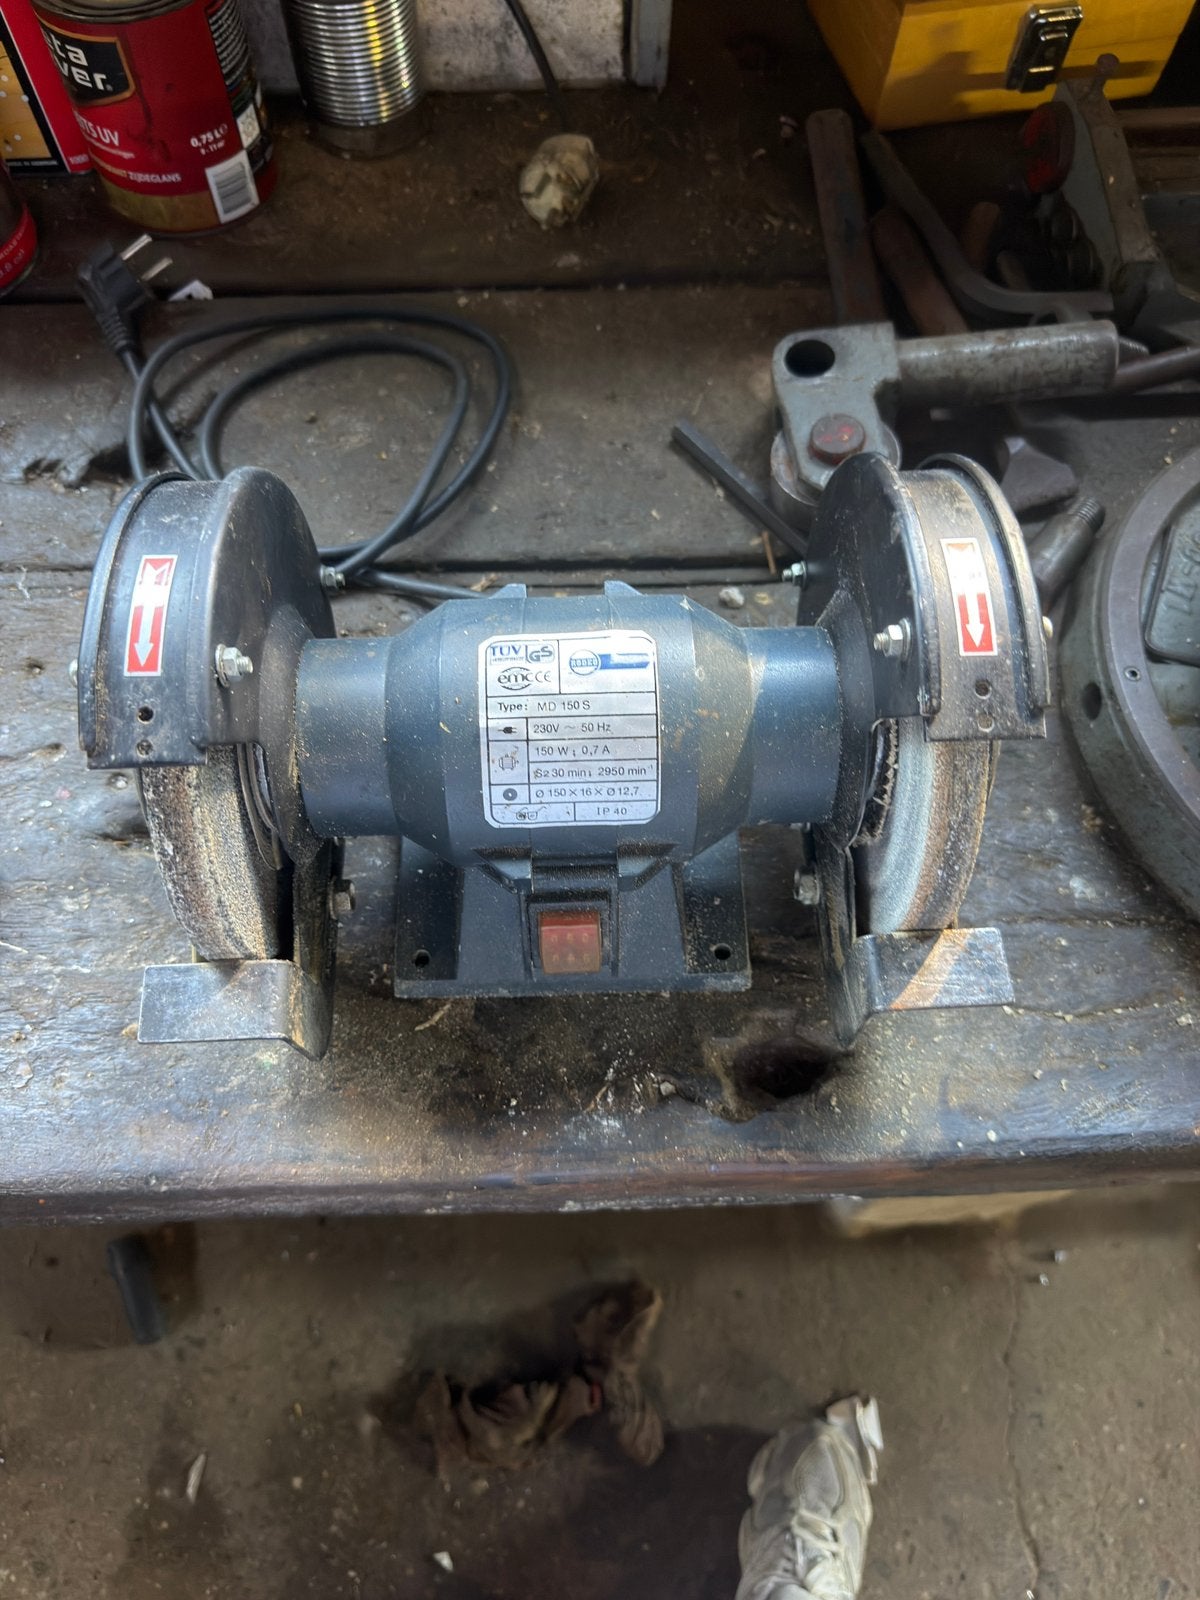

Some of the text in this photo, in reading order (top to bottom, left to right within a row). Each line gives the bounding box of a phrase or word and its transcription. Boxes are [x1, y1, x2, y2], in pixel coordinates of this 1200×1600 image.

[96, 125, 119, 147] UV
[497, 700, 591, 713] Type: MD 150 S
[533, 724, 560, 734] 230V
[581, 723, 594, 733] 50
[597, 723, 611, 733] Hz
[535, 747, 554, 756] 150
[581, 746, 599, 756] 0,7
[602, 745, 610, 755] A
[552, 768, 565, 777] 30
[598, 766, 625, 776] 2950
[549, 788, 567, 797] 150
[580, 787, 592, 796] 16
[613, 807, 627, 816] 40
